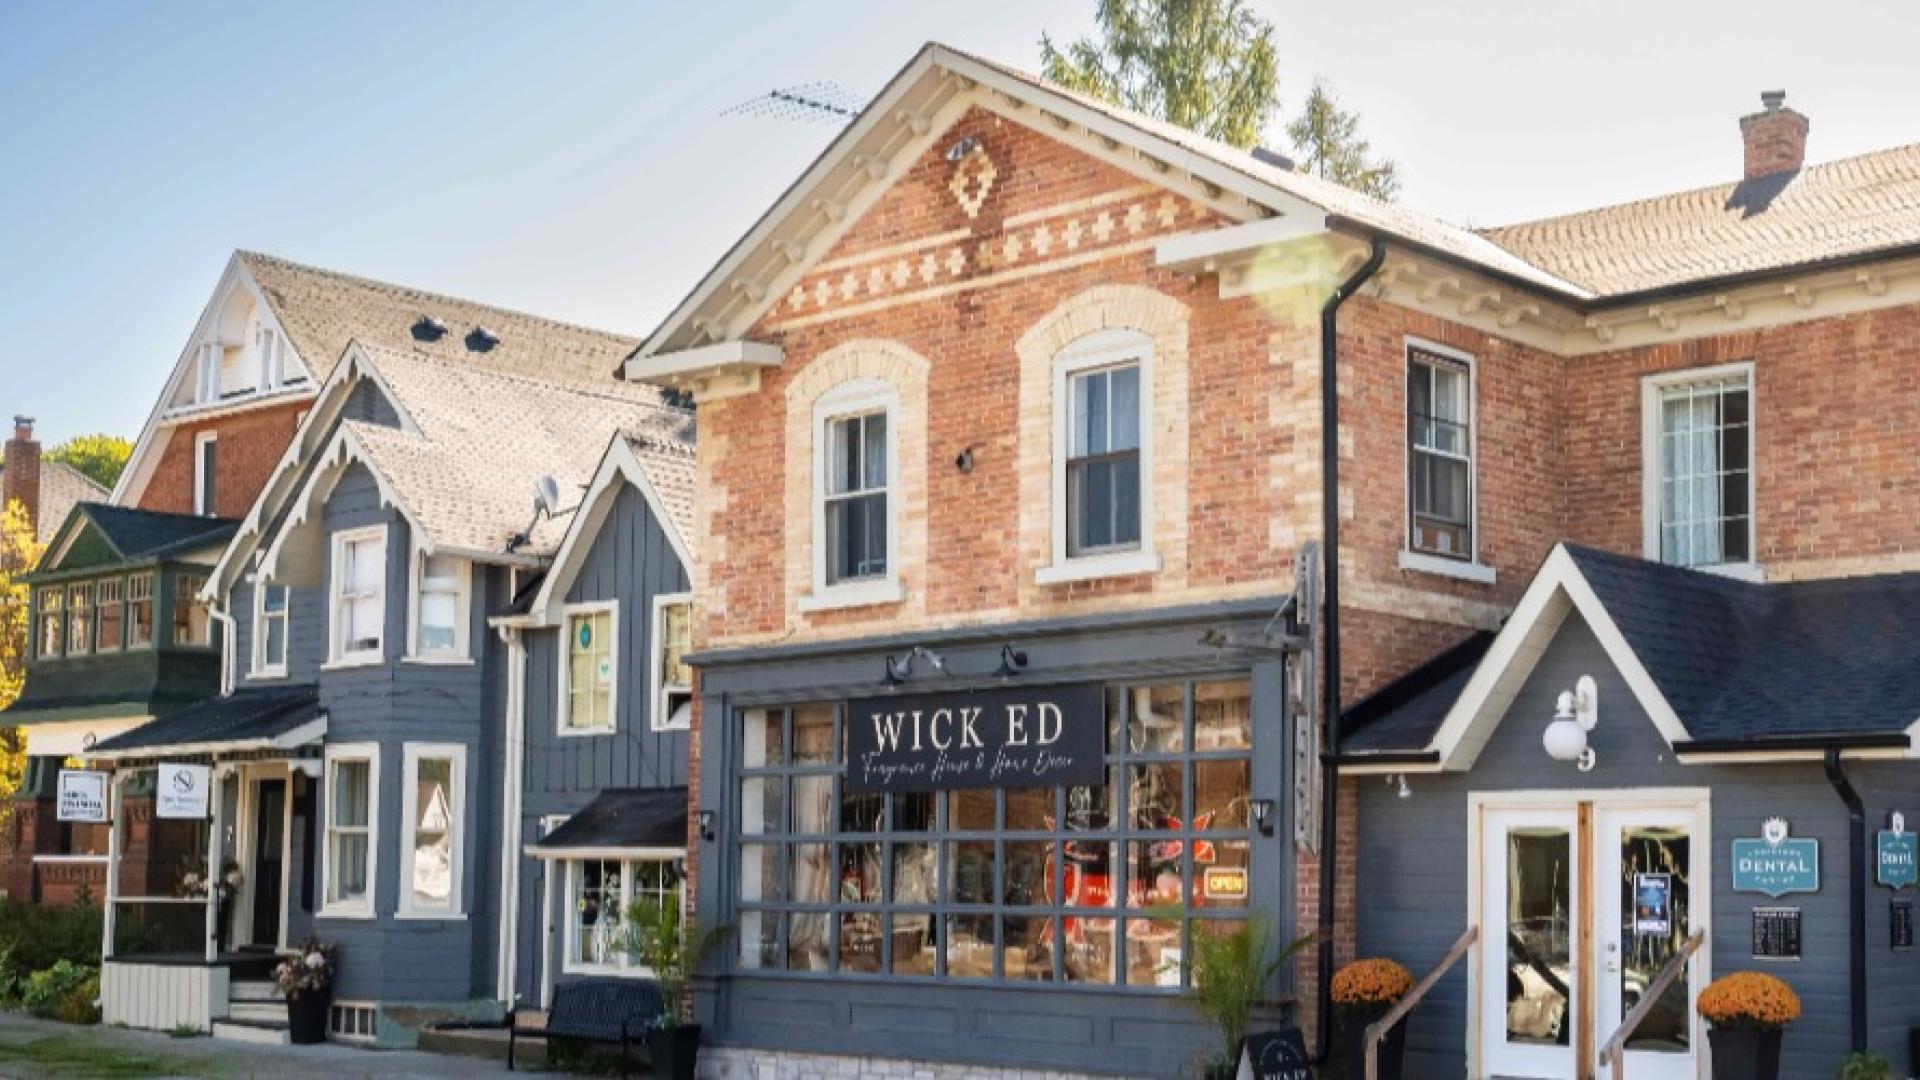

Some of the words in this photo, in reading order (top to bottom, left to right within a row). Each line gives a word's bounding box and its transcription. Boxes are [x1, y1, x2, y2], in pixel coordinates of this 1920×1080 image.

[871, 706, 985, 752] WICK
[1005, 702, 1064, 747] ED
[1739, 858, 1811, 874] DENTAL
[1209, 876, 1243, 890] OPEN
